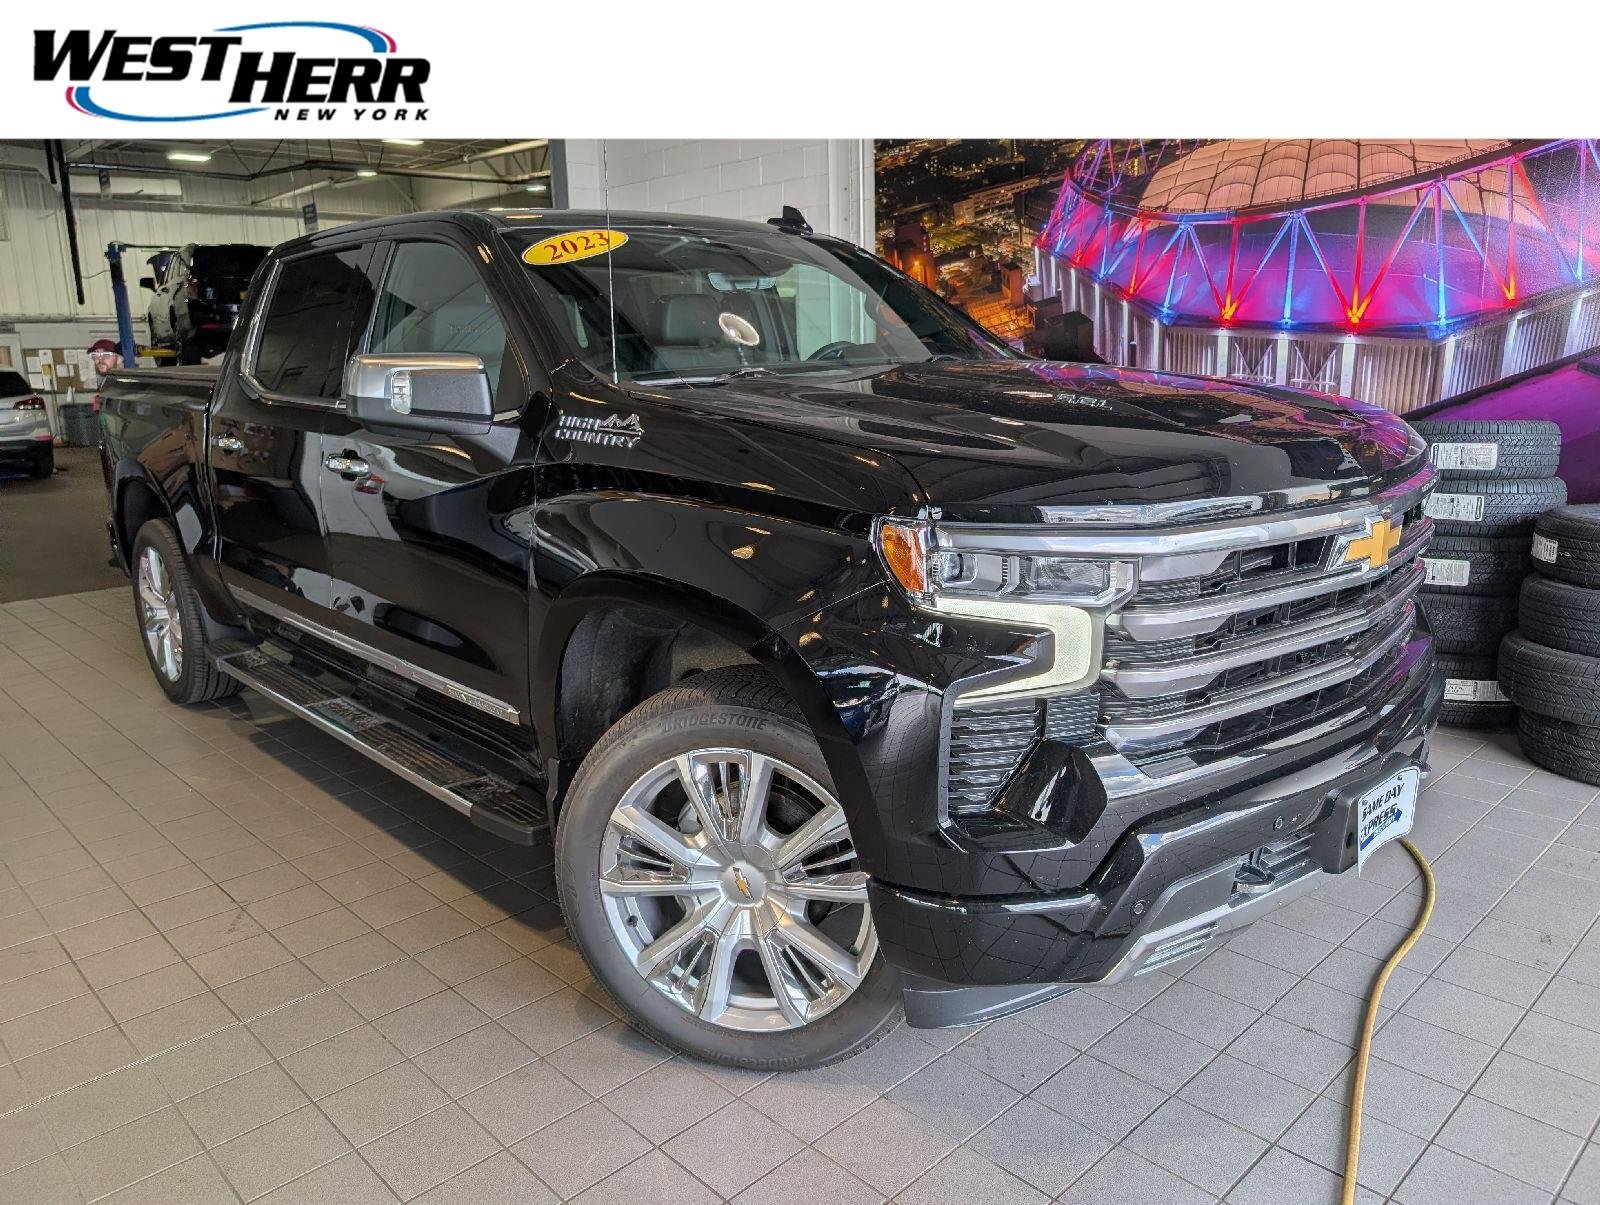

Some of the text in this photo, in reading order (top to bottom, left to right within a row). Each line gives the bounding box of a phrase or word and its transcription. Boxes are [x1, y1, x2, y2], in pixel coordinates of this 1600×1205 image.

[543, 232, 610, 261] 2023
[559, 415, 601, 430] HIGH
[555, 429, 641, 448] COUNTRY
[1362, 782, 1405, 821] SAME DAY
